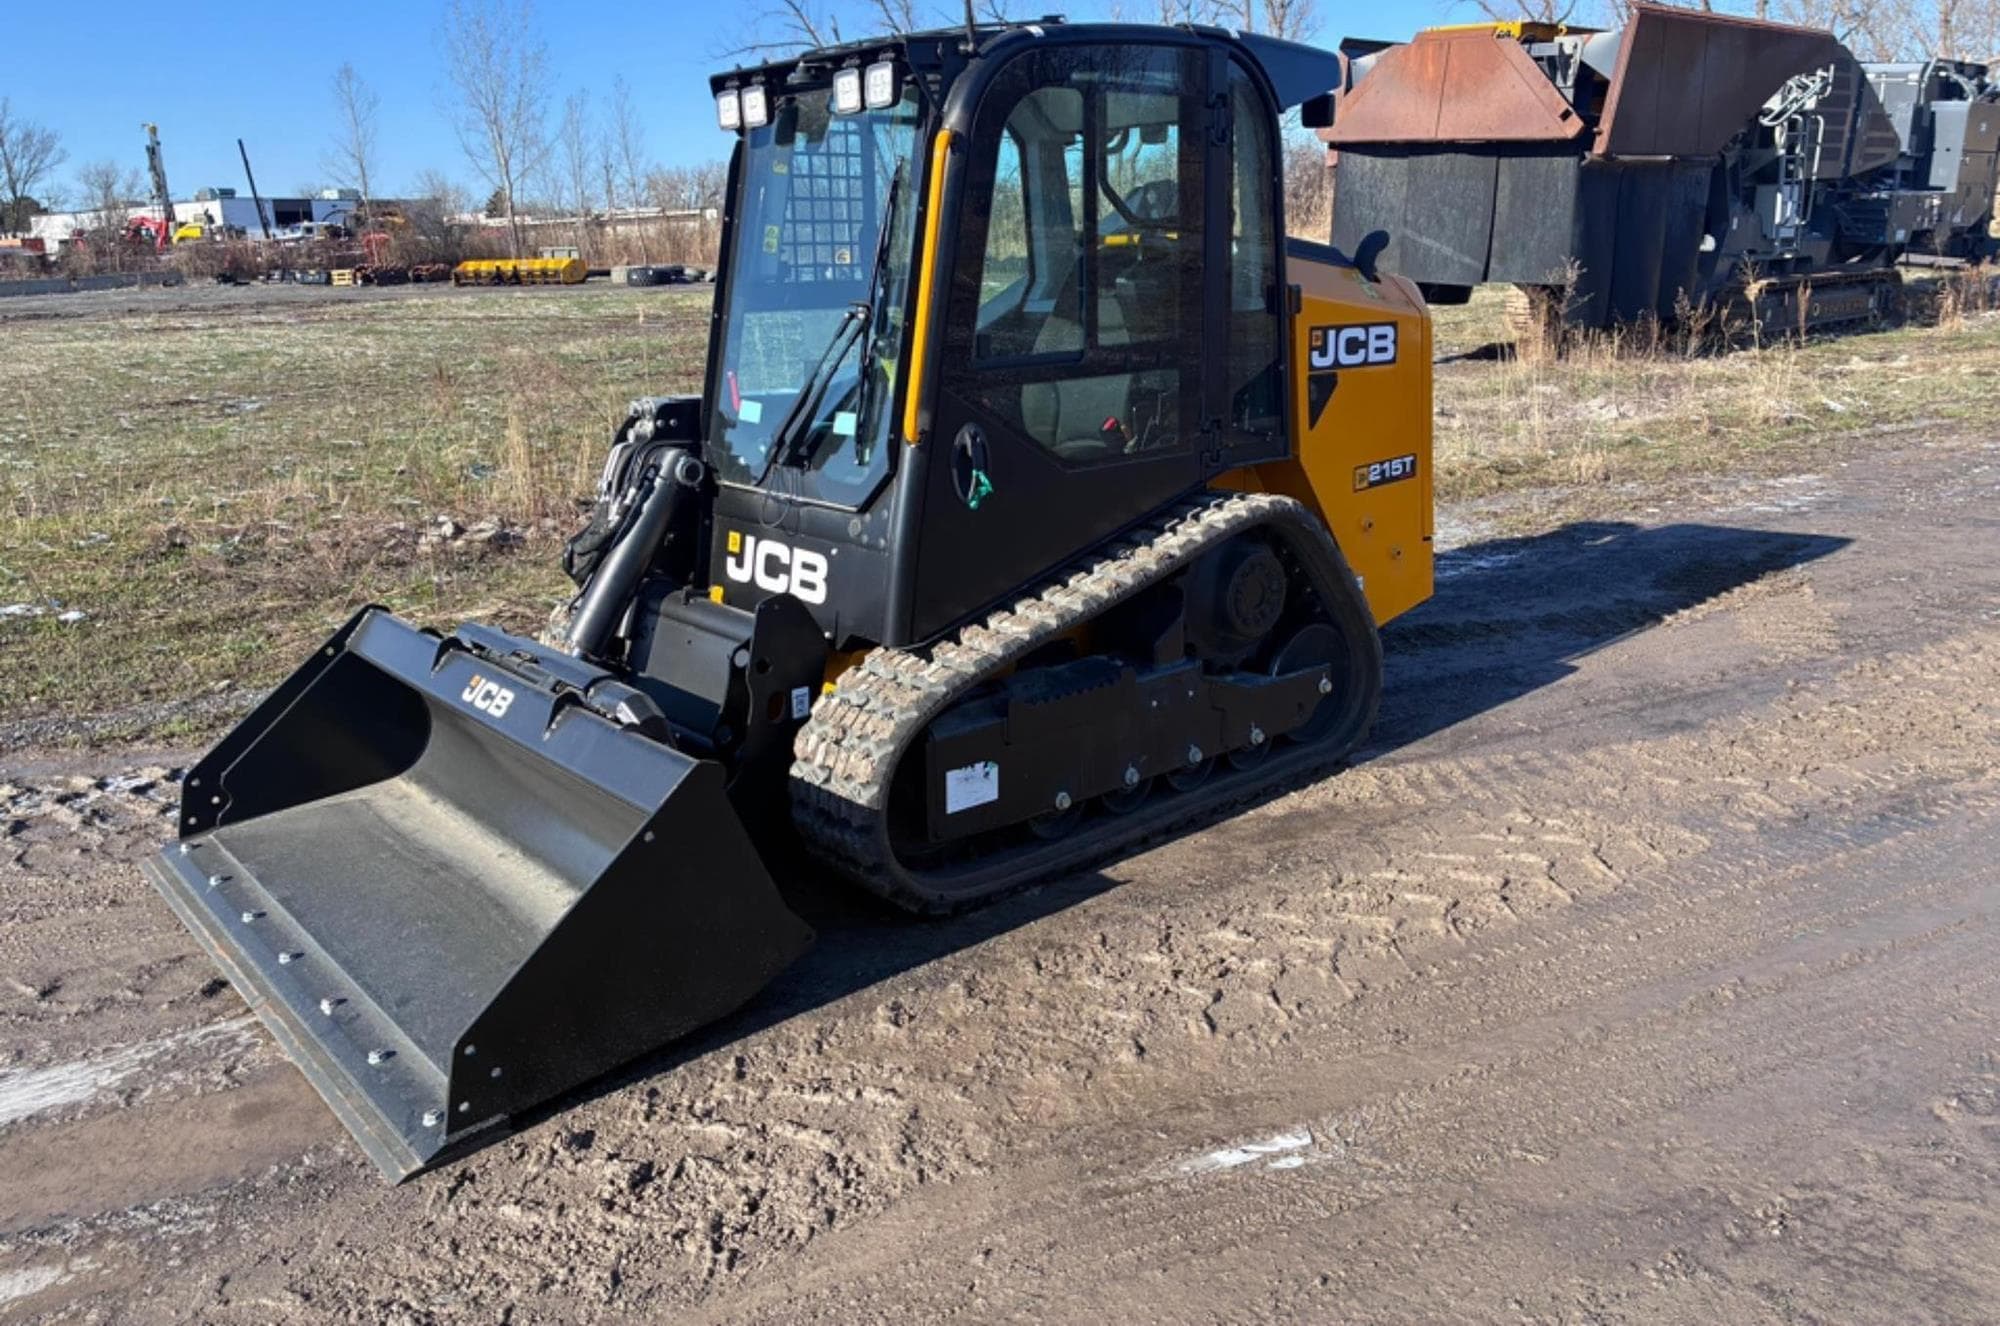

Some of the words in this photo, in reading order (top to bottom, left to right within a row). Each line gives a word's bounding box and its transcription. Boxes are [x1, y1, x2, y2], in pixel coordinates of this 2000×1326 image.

[1311, 325, 1396, 367] JCB
[1368, 456, 1414, 481] 215T
[726, 533, 828, 604] JCB
[462, 677, 515, 718] JCB
